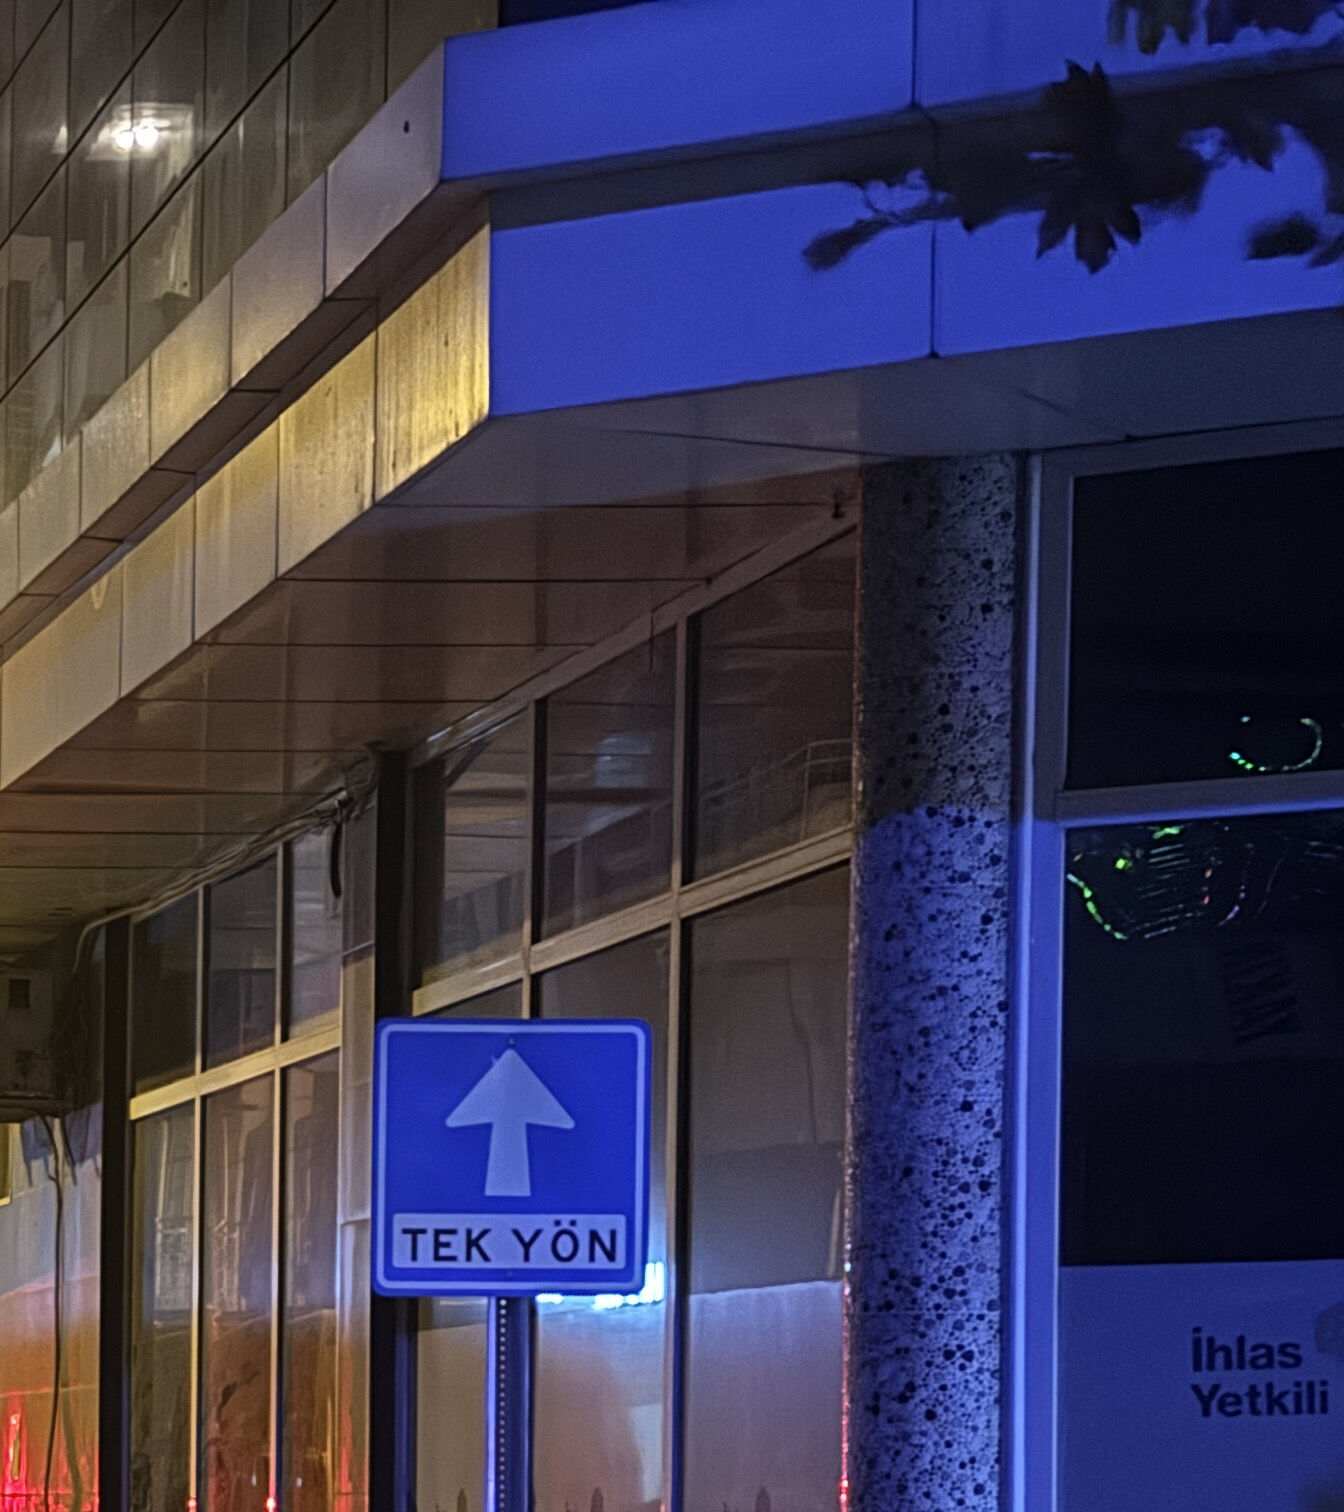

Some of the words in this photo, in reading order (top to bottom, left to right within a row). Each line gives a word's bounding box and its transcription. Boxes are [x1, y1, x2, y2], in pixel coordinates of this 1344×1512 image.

[402, 1228, 492, 1263] TEK
[512, 1219, 617, 1263] YÖN
[1192, 1326, 1302, 1372] İhlas
[1190, 1380, 1329, 1417] Yetkili
